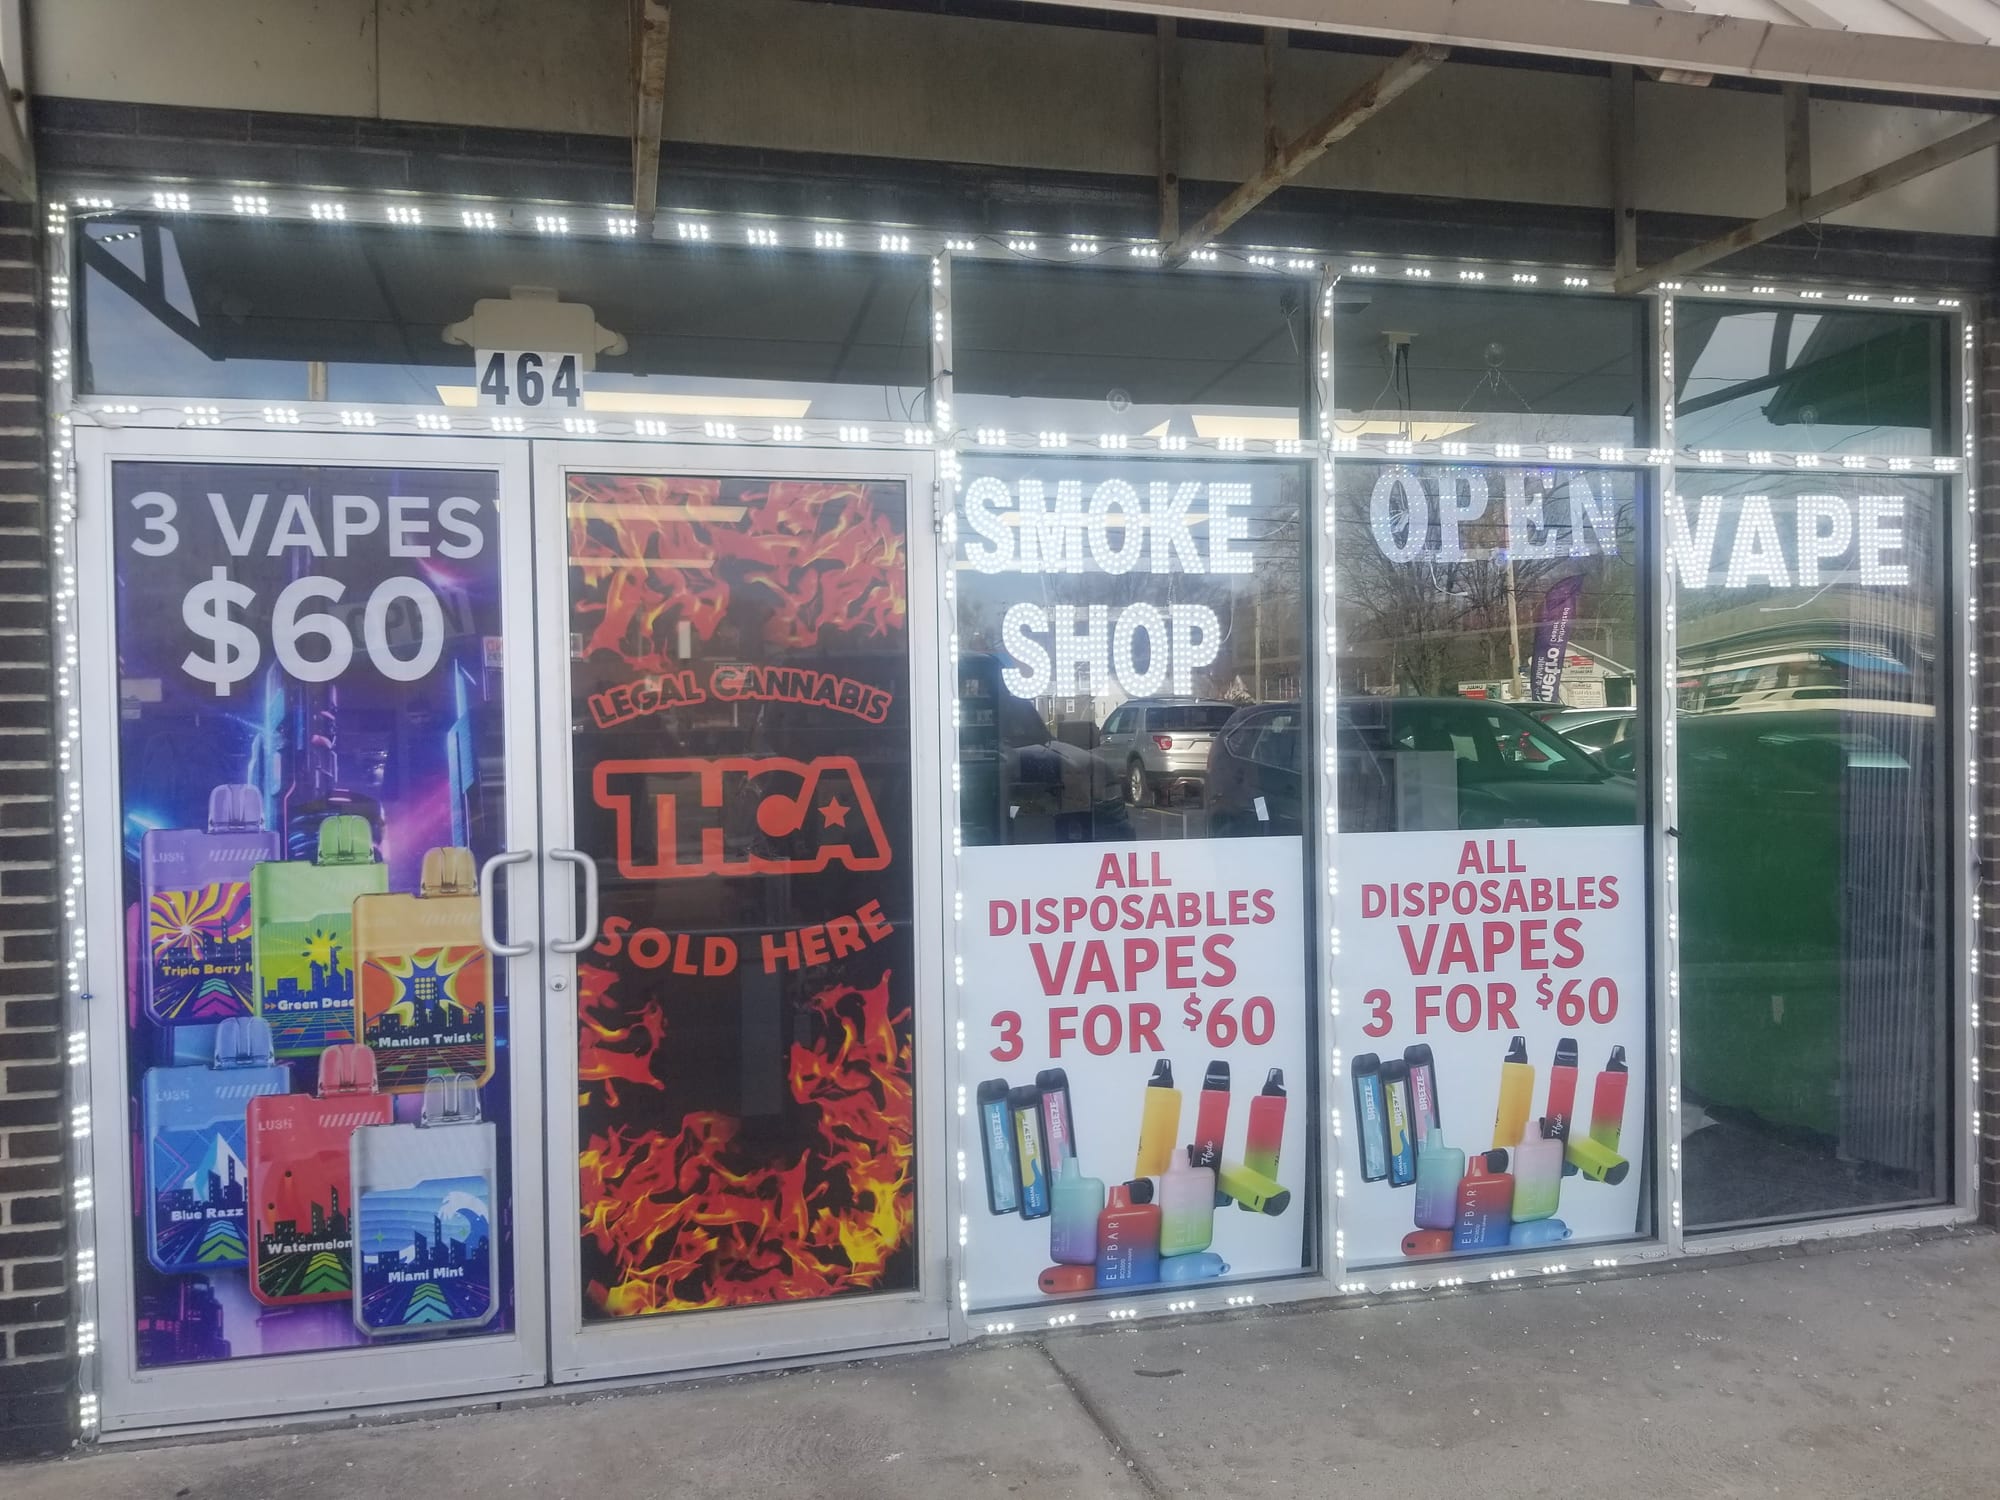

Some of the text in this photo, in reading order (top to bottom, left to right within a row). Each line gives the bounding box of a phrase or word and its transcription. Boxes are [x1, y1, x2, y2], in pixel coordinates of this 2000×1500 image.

[480, 352, 581, 408] 464
[131, 491, 485, 559] 3 VAPES
[964, 476, 1254, 575] SMOKE
[1370, 463, 1620, 563] OPEN
[1672, 495, 1909, 588] VAPE
[181, 566, 445, 697] $60
[1001, 602, 1221, 699] SHOP
[588, 665, 893, 729] LEGAL CANNABIS
[592, 756, 893, 880] THCA
[1095, 851, 1172, 889] ALL
[1457, 839, 1526, 874] ALL
[989, 888, 1275, 937] DISPOSABLES
[1361, 875, 1619, 919] DISPOSABLES
[594, 899, 895, 976] SOLD HERE
[1028, 933, 1237, 996] VAPES
[1397, 917, 1585, 976] VAPES
[162, 963, 200, 977] Triple
[203, 963, 242, 976] Berry
[277, 999, 319, 1011] Green
[989, 992, 1276, 1062] 3 FOR $60
[1362, 973, 1619, 1038] 3 FOR $60
[433, 1032, 471, 1045] Twist
[1416, 1074, 1428, 1111] BREEZE
[171, 1206, 244, 1222] Blue Razz
[267, 1238, 353, 1255] Watermelon
[388, 1266, 464, 1284] Miami Mint
